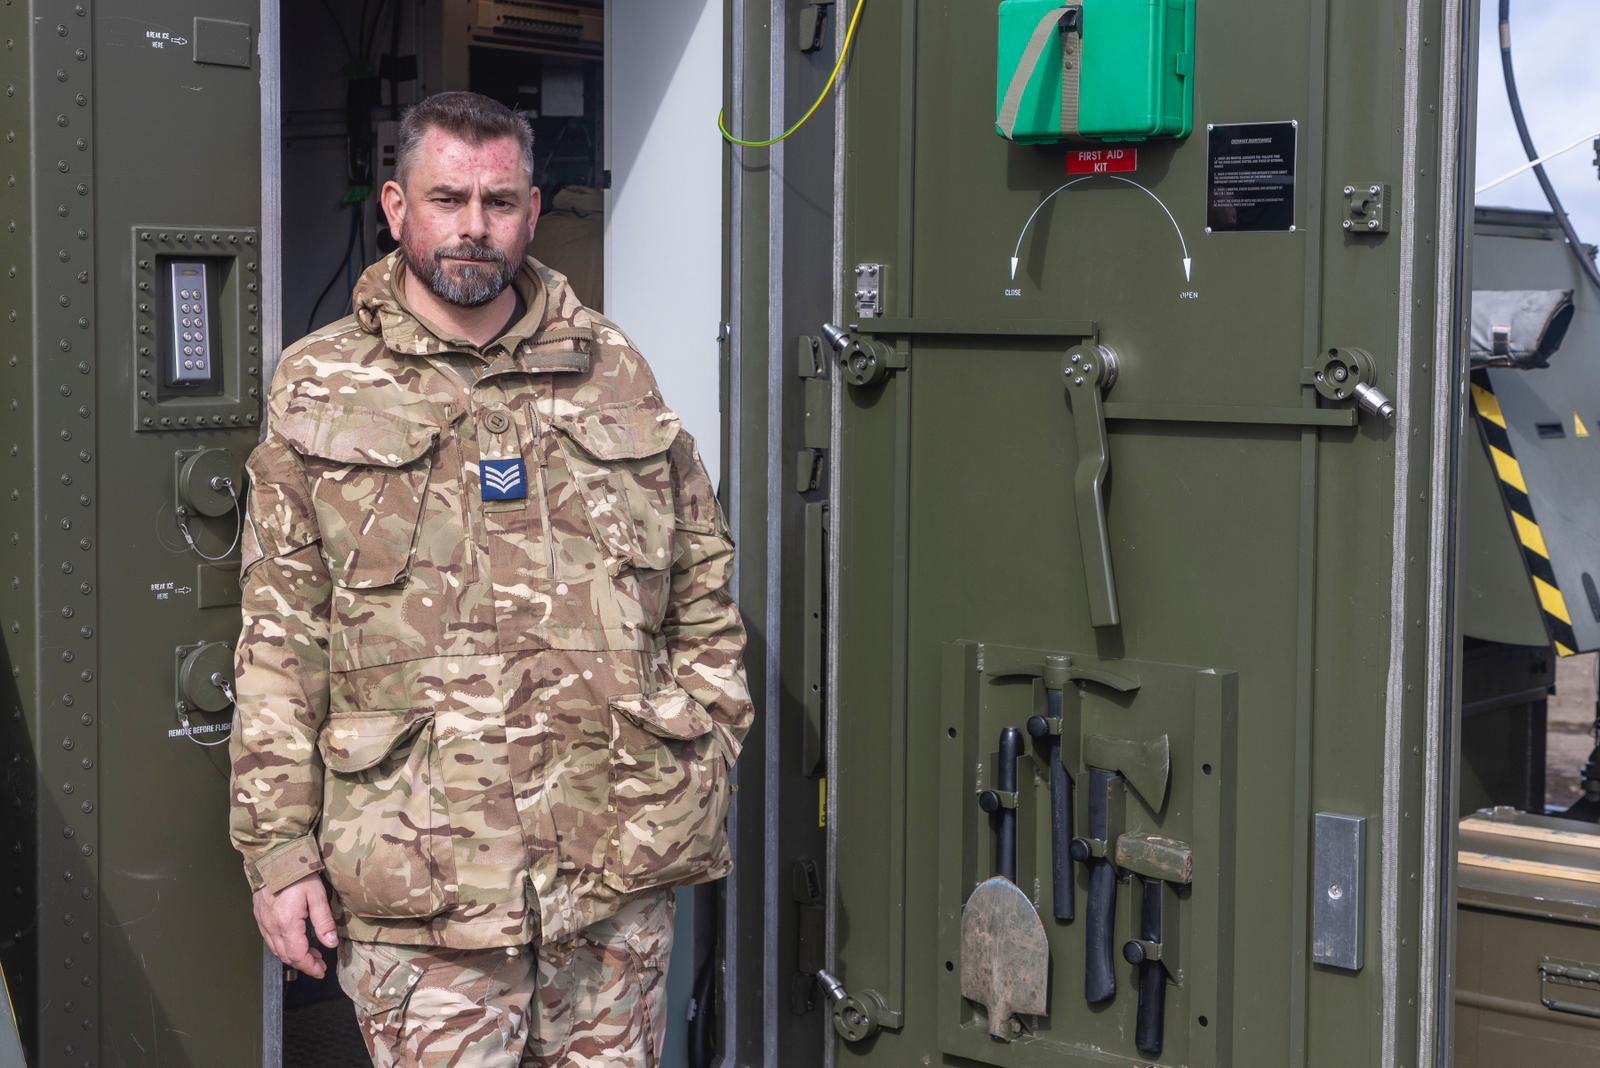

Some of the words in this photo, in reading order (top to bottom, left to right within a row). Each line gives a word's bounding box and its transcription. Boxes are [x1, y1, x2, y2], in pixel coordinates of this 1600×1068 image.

[162, 32, 170, 40] ICE
[1078, 150, 1102, 161] FIRST
[1106, 149, 1124, 160] AID
[1094, 162, 1108, 173] KIT
[1004, 288, 1021, 296] CLOSE
[168, 727, 192, 738] REMOVE
[193, 724, 214, 734] BEFORE
